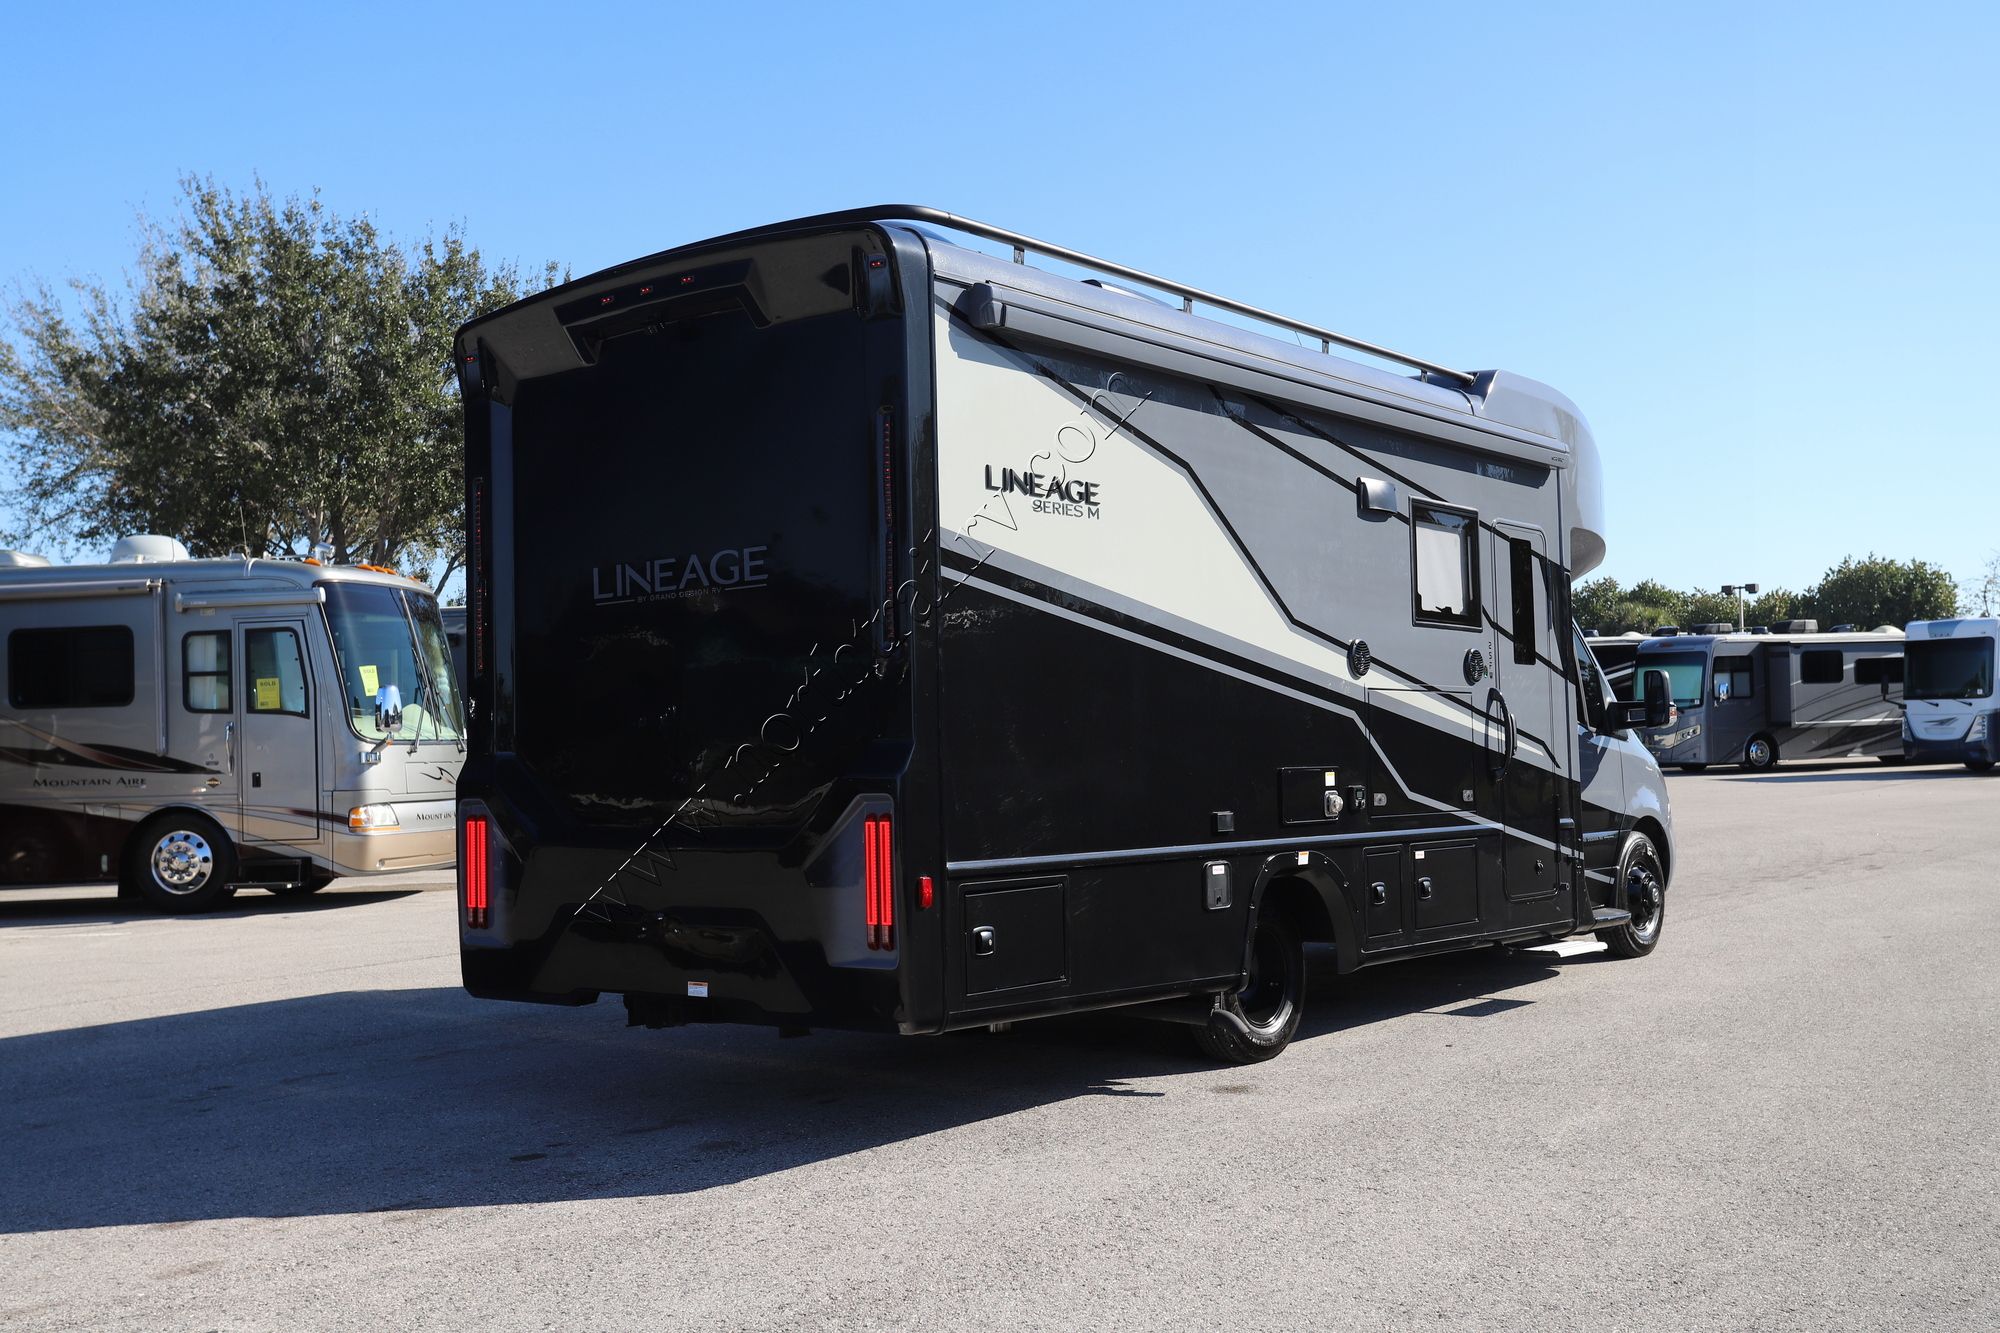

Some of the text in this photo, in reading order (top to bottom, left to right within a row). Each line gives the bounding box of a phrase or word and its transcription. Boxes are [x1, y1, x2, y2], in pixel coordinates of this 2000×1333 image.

[984, 464, 1101, 506] LINEAGE
[1032, 499, 1100, 520] SERIES M
[593, 546, 769, 600] LINEAGE
[637, 595, 647, 603] BY
[649, 592, 677, 601] GRAND
[679, 588, 709, 599] DESIGN
[33, 776, 146, 787] MOUNTAIN AIRE
